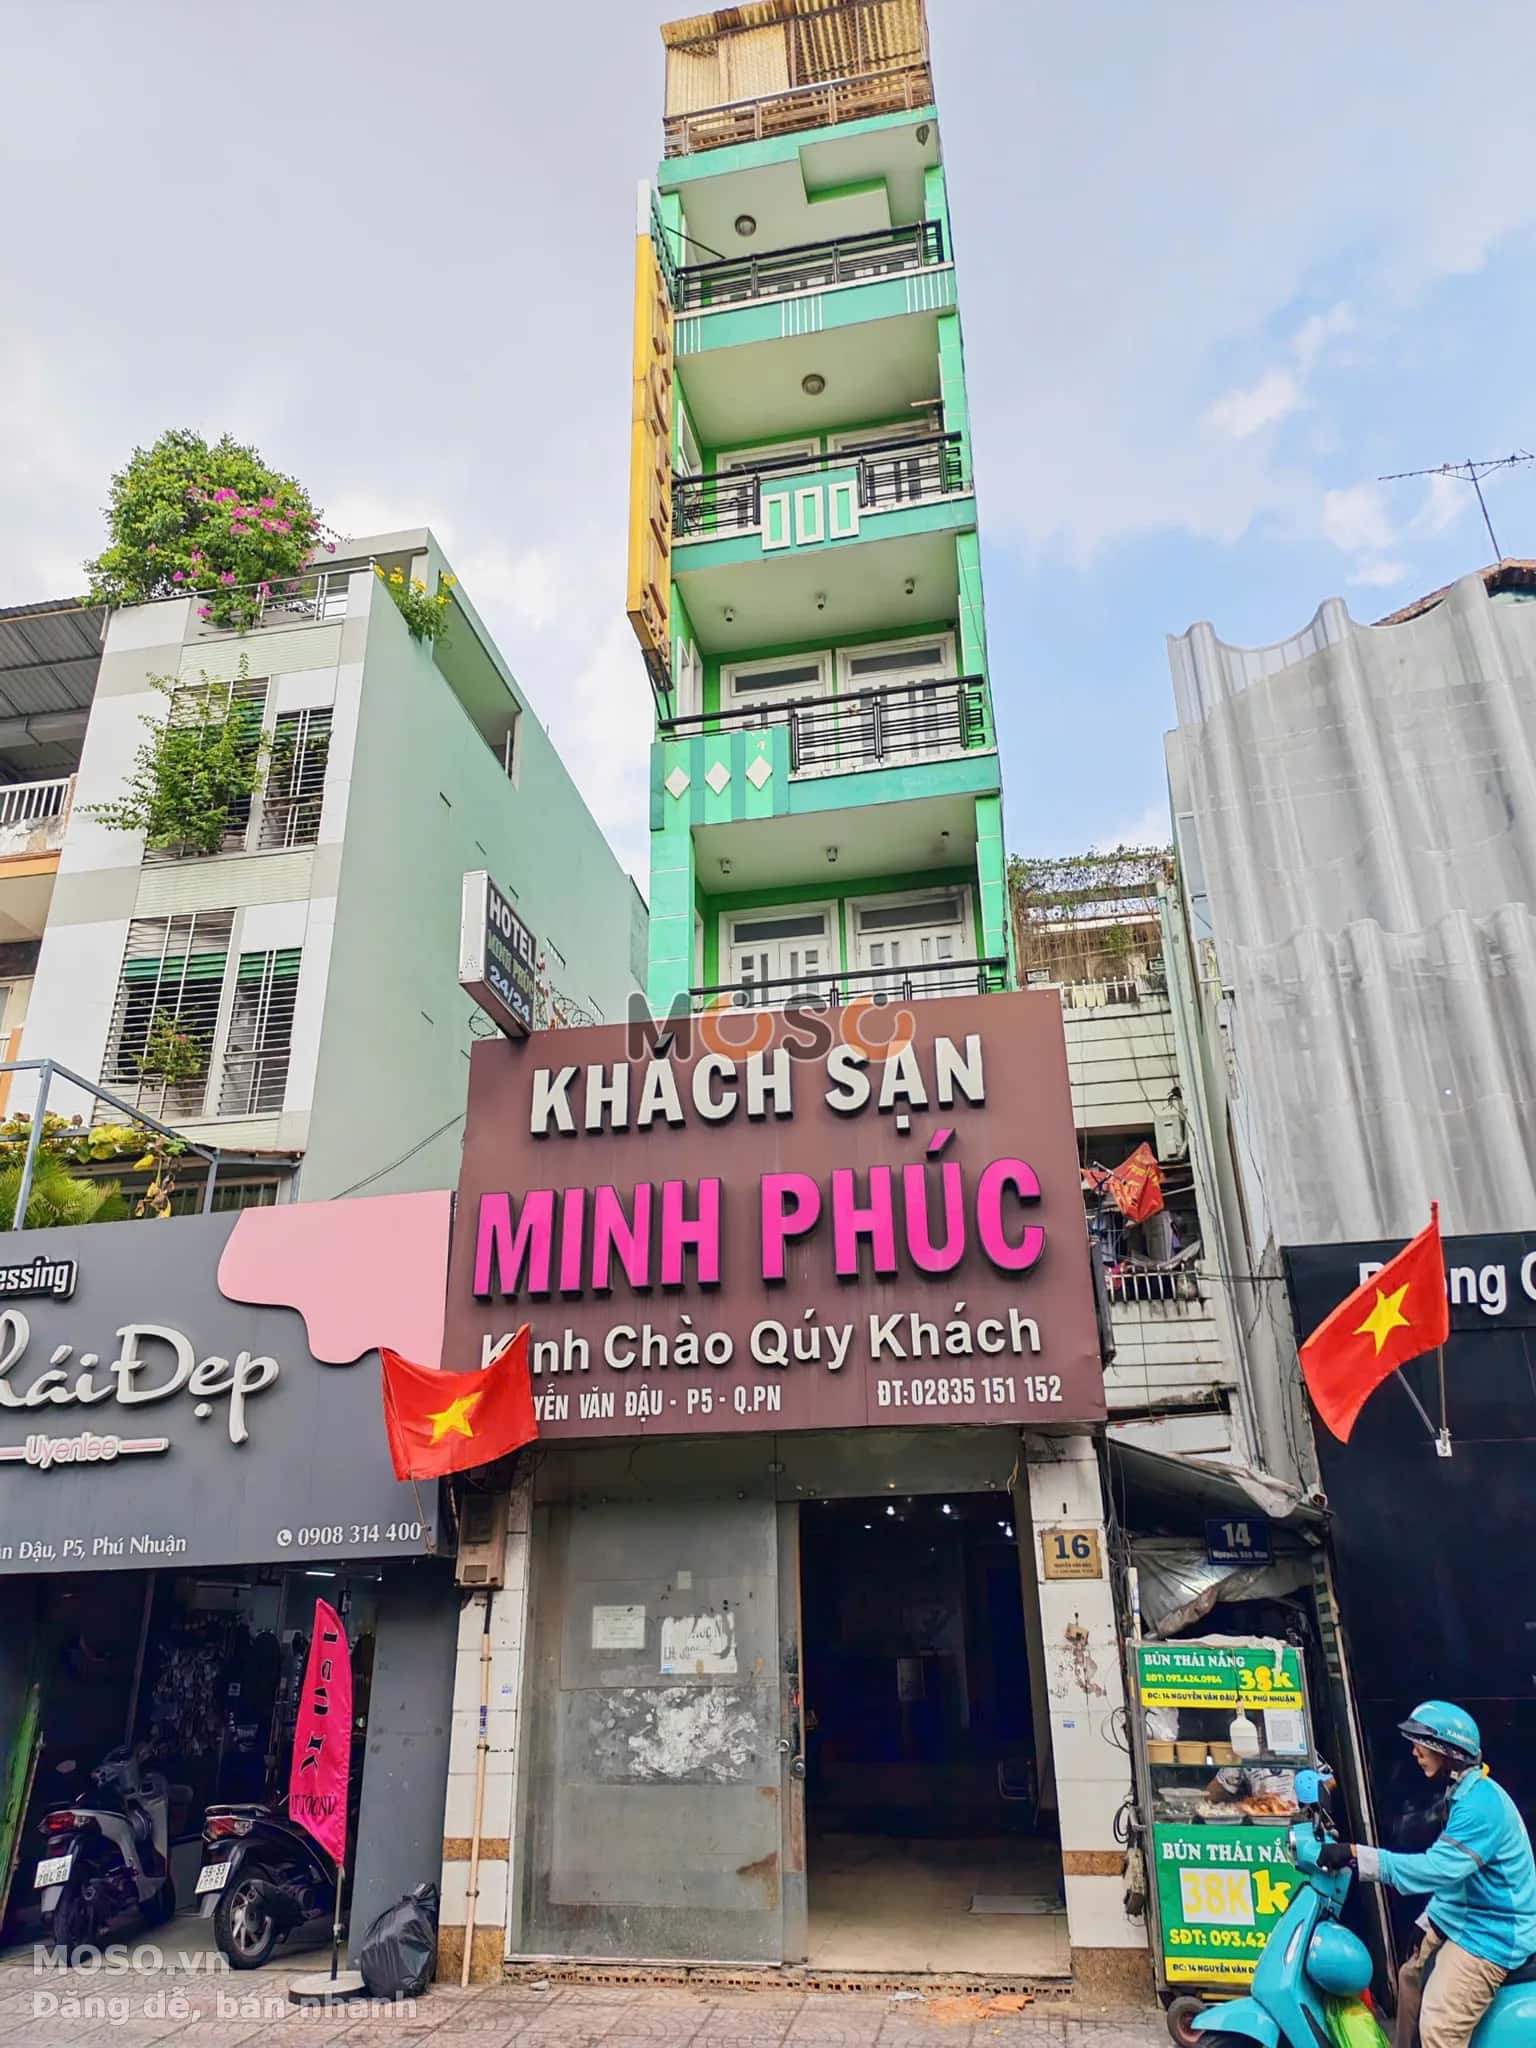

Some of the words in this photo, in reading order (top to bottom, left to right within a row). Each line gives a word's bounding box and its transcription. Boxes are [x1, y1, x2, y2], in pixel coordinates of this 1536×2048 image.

[489, 888, 535, 970] HOTEL
[489, 964, 531, 1022] 24/24
[530, 1032, 794, 1137] KHÁCH
[824, 1034, 986, 1134] SẠN
[472, 1177, 722, 1299] MINH
[760, 1128, 1046, 1282] PHÚC
[480, 1323, 590, 1375] Knh
[603, 1314, 735, 1369] Chào
[868, 1302, 1042, 1360] Khách
[110, 1323, 280, 1444] Đẹp
[911, 1377, 977, 1406] 02835
[981, 1377, 1016, 1405] 151
[1023, 1375, 1063, 1403] 152
[579, 1386, 615, 1419] VĂN
[625, 1384, 663, 1423] ĐẬU
[687, 1387, 712, 1414] P5
[733, 1384, 782, 1413] Q.PN
[18, 1541, 57, 1563] Đậu,
[62, 1539, 86, 1560] P5,
[92, 1536, 124, 1556] Phú
[129, 1534, 187, 1556] Nhuận
[298, 1526, 343, 1547] 0908
[349, 1524, 380, 1544] 314
[385, 1522, 422, 1542] 400
[1054, 1534, 1091, 1560] 16
[1220, 1522, 1253, 1548] 14
[1143, 1651, 1171, 1666] BÚN
[1173, 1652, 1207, 1668] THÁI
[1162, 1839, 1201, 1860] BÚN
[1206, 1840, 1254, 1862] THÁI
[1257, 1838, 1291, 1863] NẮ
[1183, 1873, 1252, 1916] 38K
[1170, 1929, 1207, 1946] SĐT:
[1188, 1964, 1196, 1972] 14
[1197, 1962, 1230, 1974] NGUYỄN
